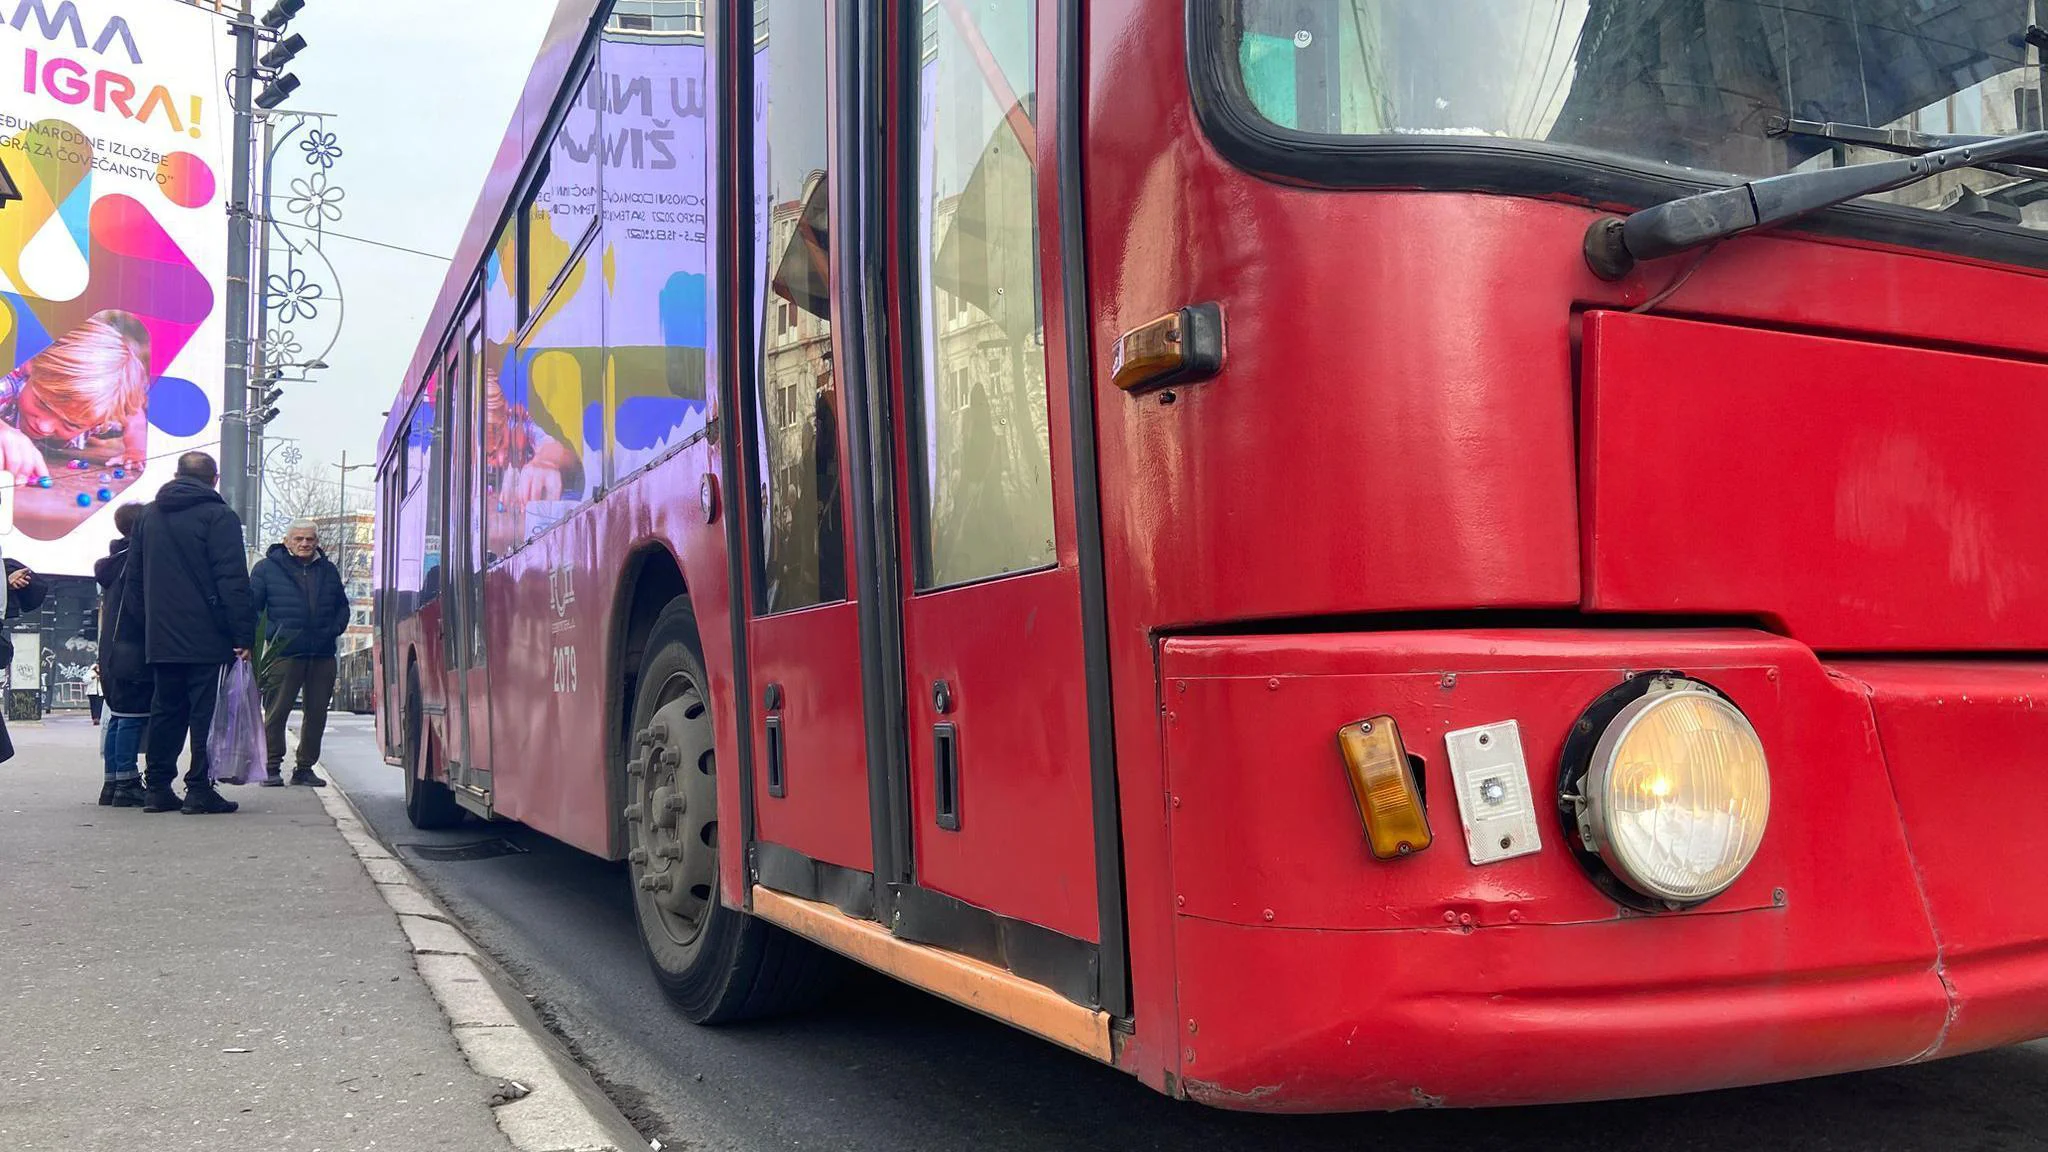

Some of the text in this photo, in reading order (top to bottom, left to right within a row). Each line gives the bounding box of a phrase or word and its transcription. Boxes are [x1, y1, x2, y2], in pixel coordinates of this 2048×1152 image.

[0, 0, 143, 64] MA
[24, 48, 202, 139] IGRA!
[34, 142, 53, 159] ZA
[109, 141, 169, 167] IZLOŽBE
[553, 645, 577, 693] 2079
